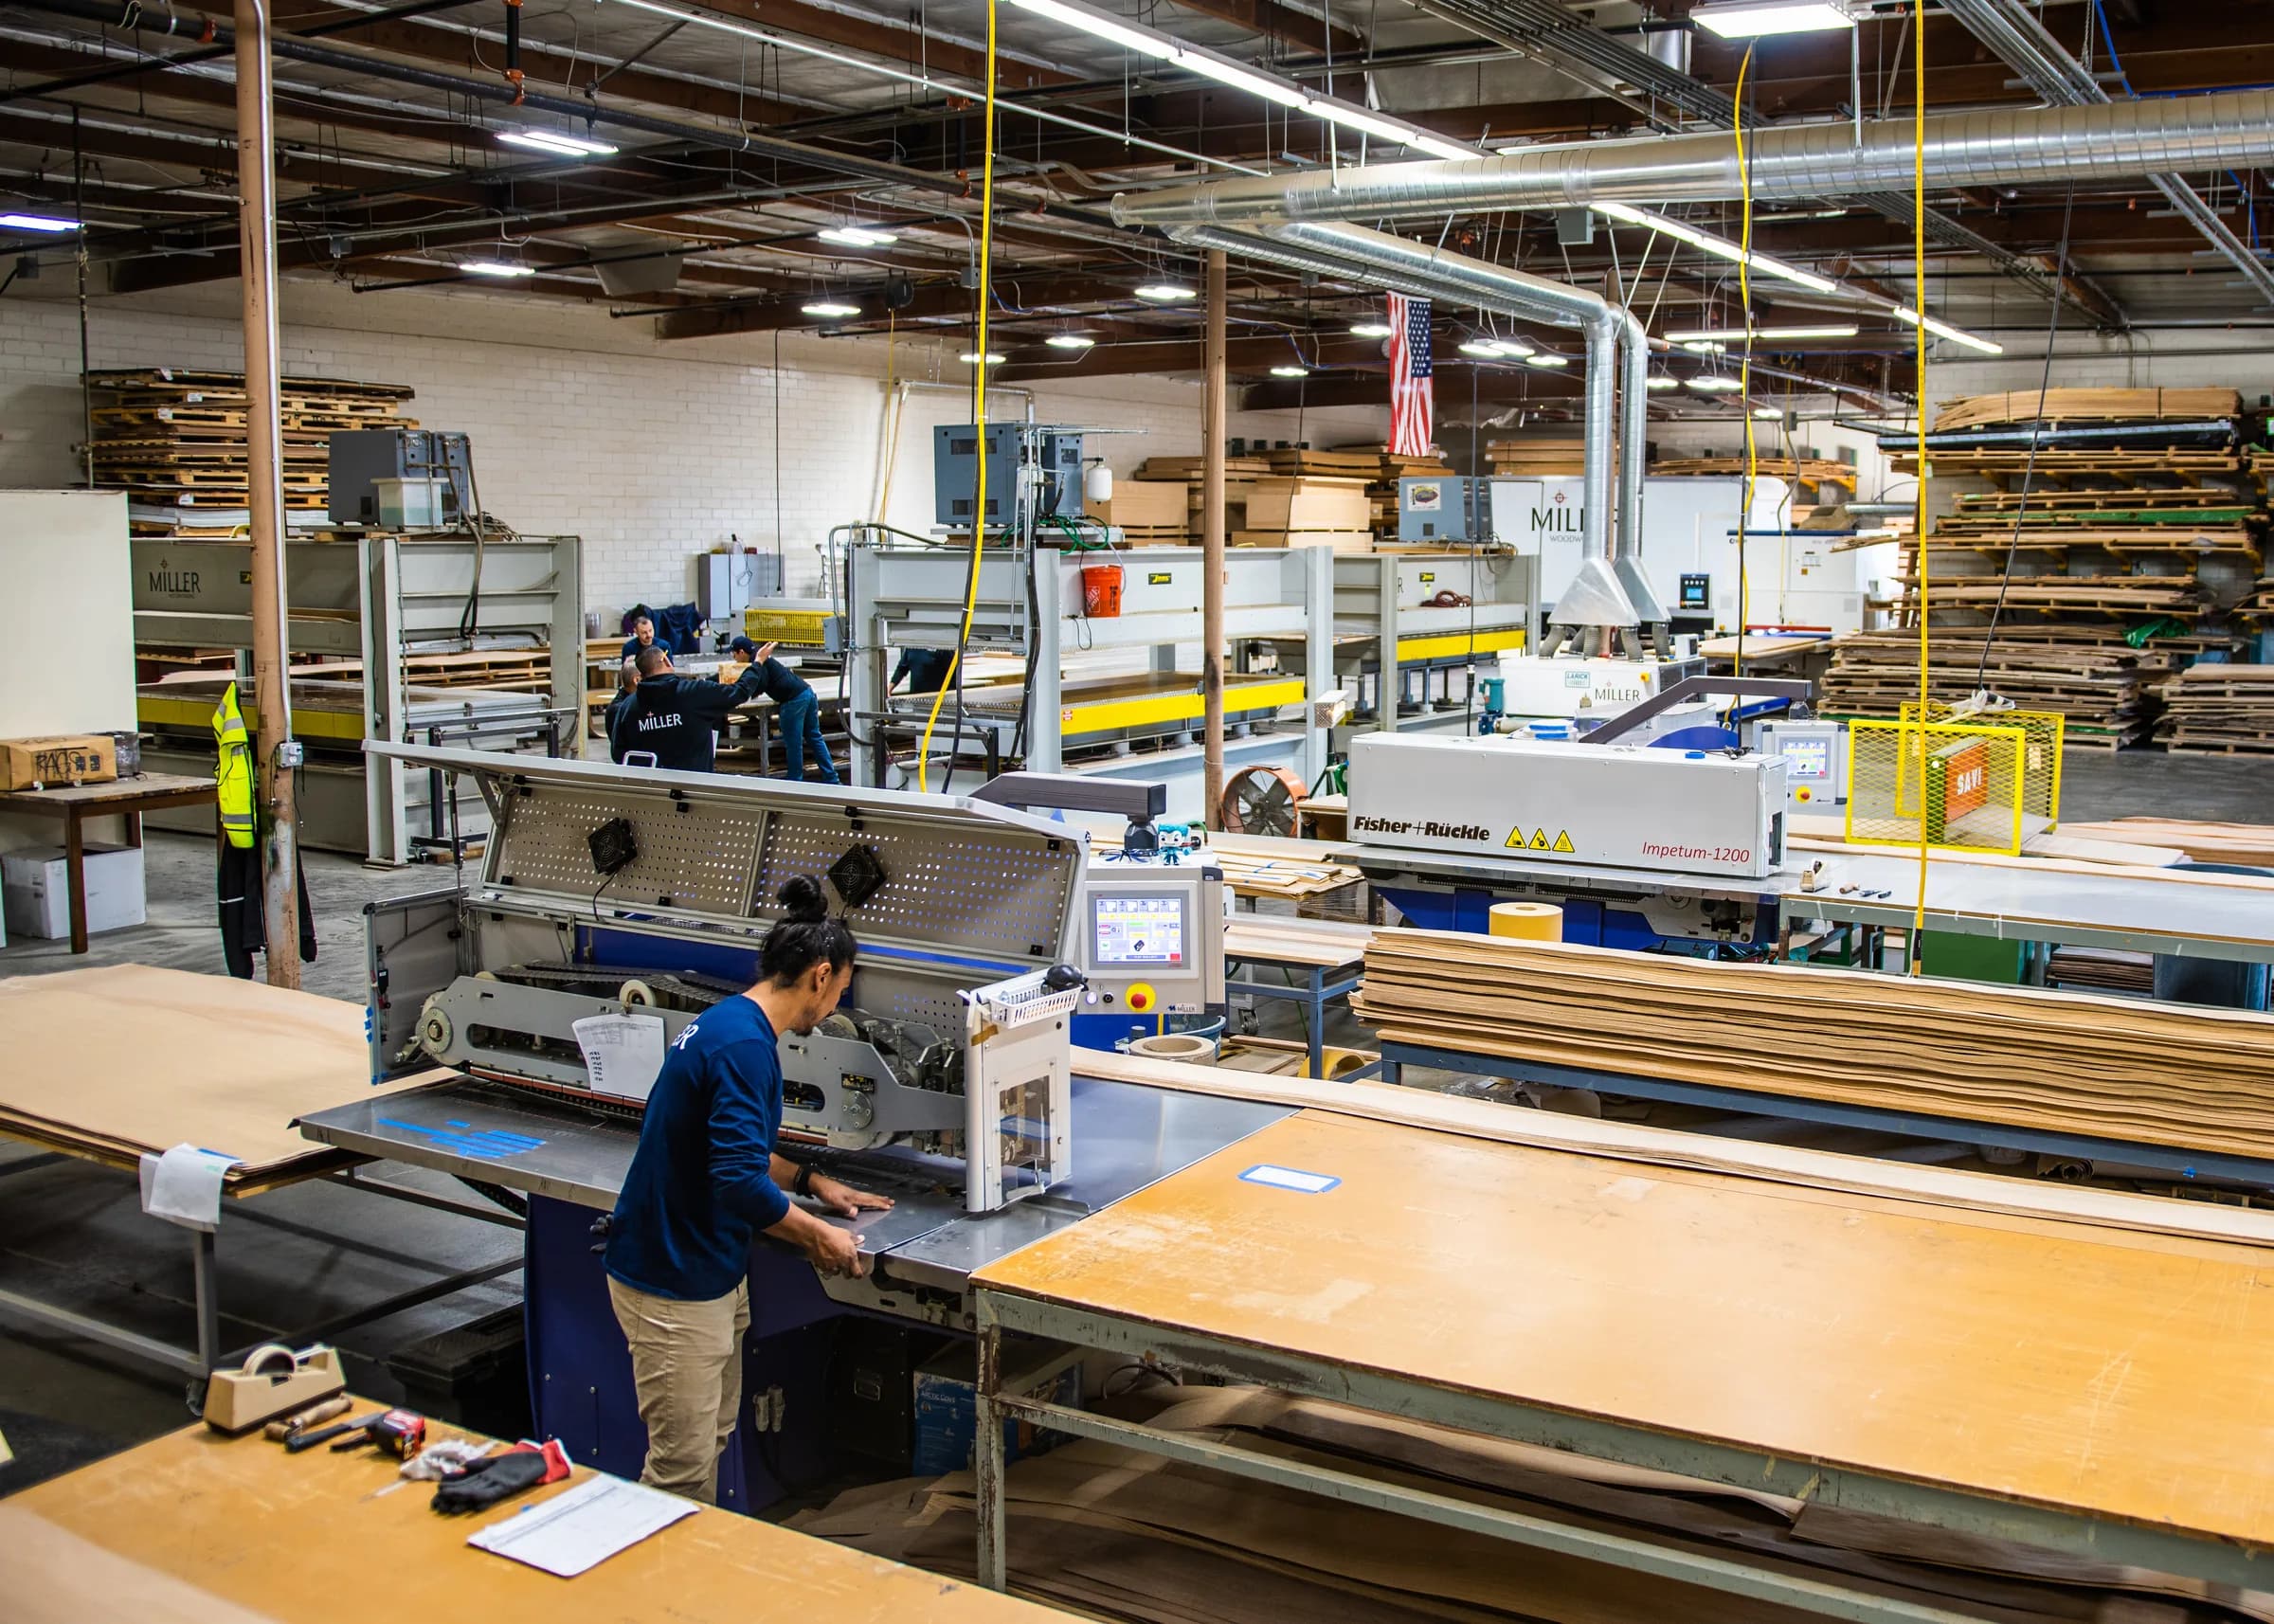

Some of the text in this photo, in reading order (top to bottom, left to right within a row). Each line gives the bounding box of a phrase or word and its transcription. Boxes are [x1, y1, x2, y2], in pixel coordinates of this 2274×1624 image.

[149, 571, 201, 593] MILLER
[1595, 688, 1640, 701] MILLER
[638, 713, 683, 732] MILLER
[1642, 840, 1751, 863] Impetum-1200
